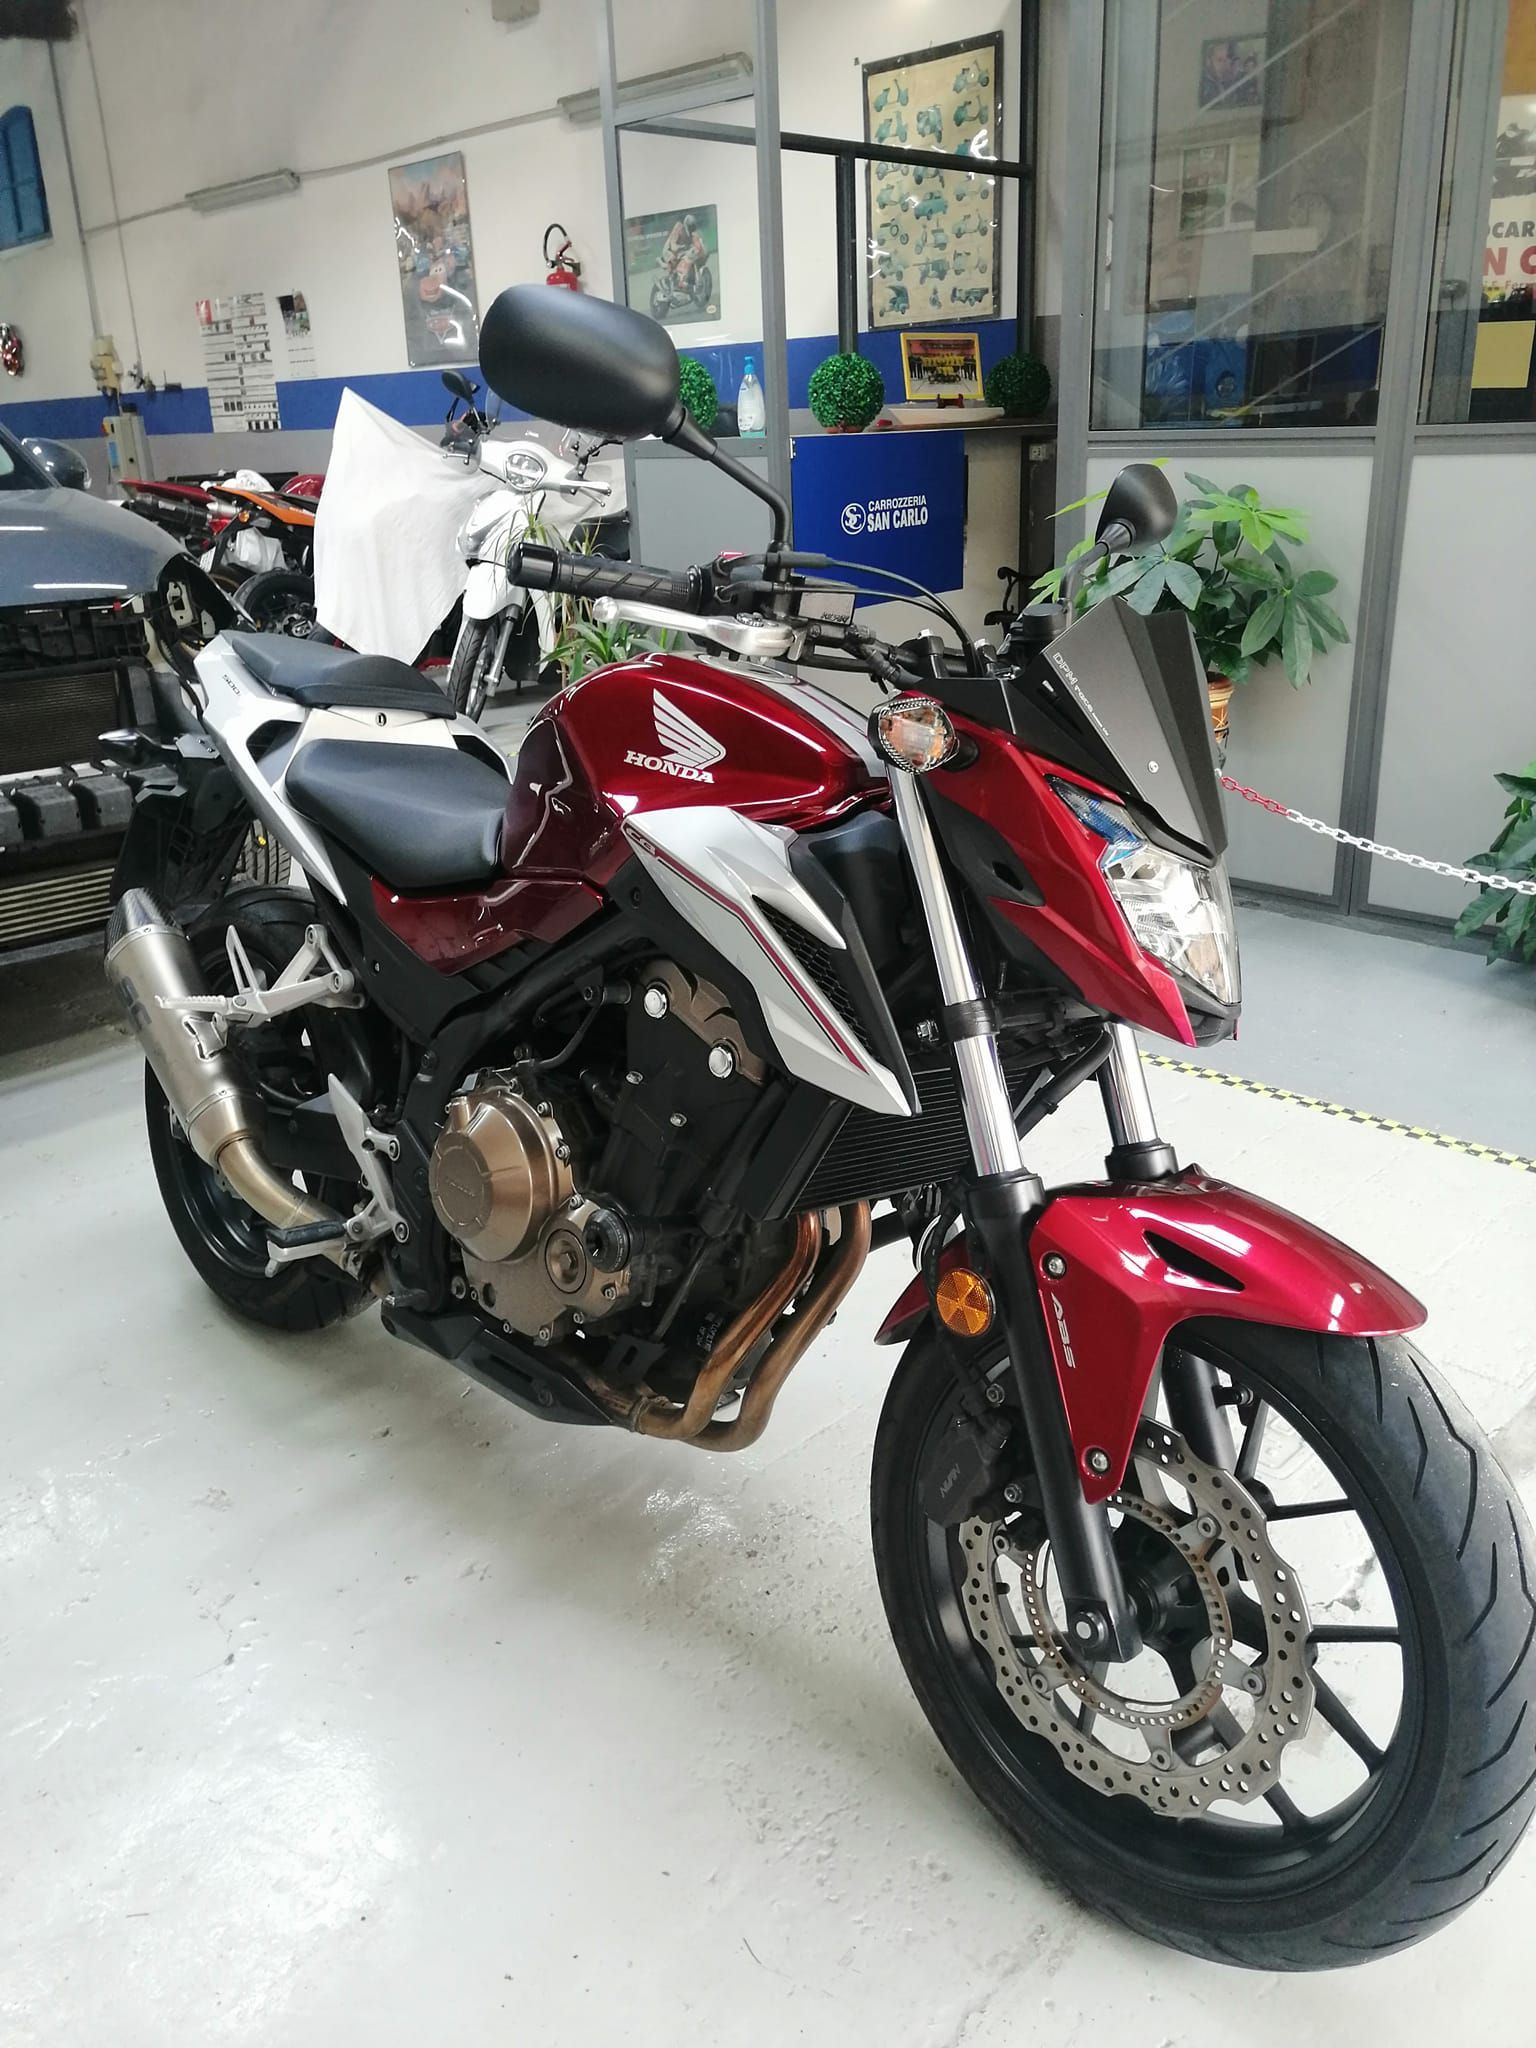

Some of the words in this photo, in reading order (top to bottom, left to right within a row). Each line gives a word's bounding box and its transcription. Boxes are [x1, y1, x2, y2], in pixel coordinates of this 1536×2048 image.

[867, 512, 890, 532] SAN
[893, 506, 929, 528] CARLO
[868, 495, 927, 512] CARROZZERIA
[1053, 652, 1079, 685] DPM
[624, 750, 715, 784] HONDA
[1051, 1291, 1076, 1369] ABS
